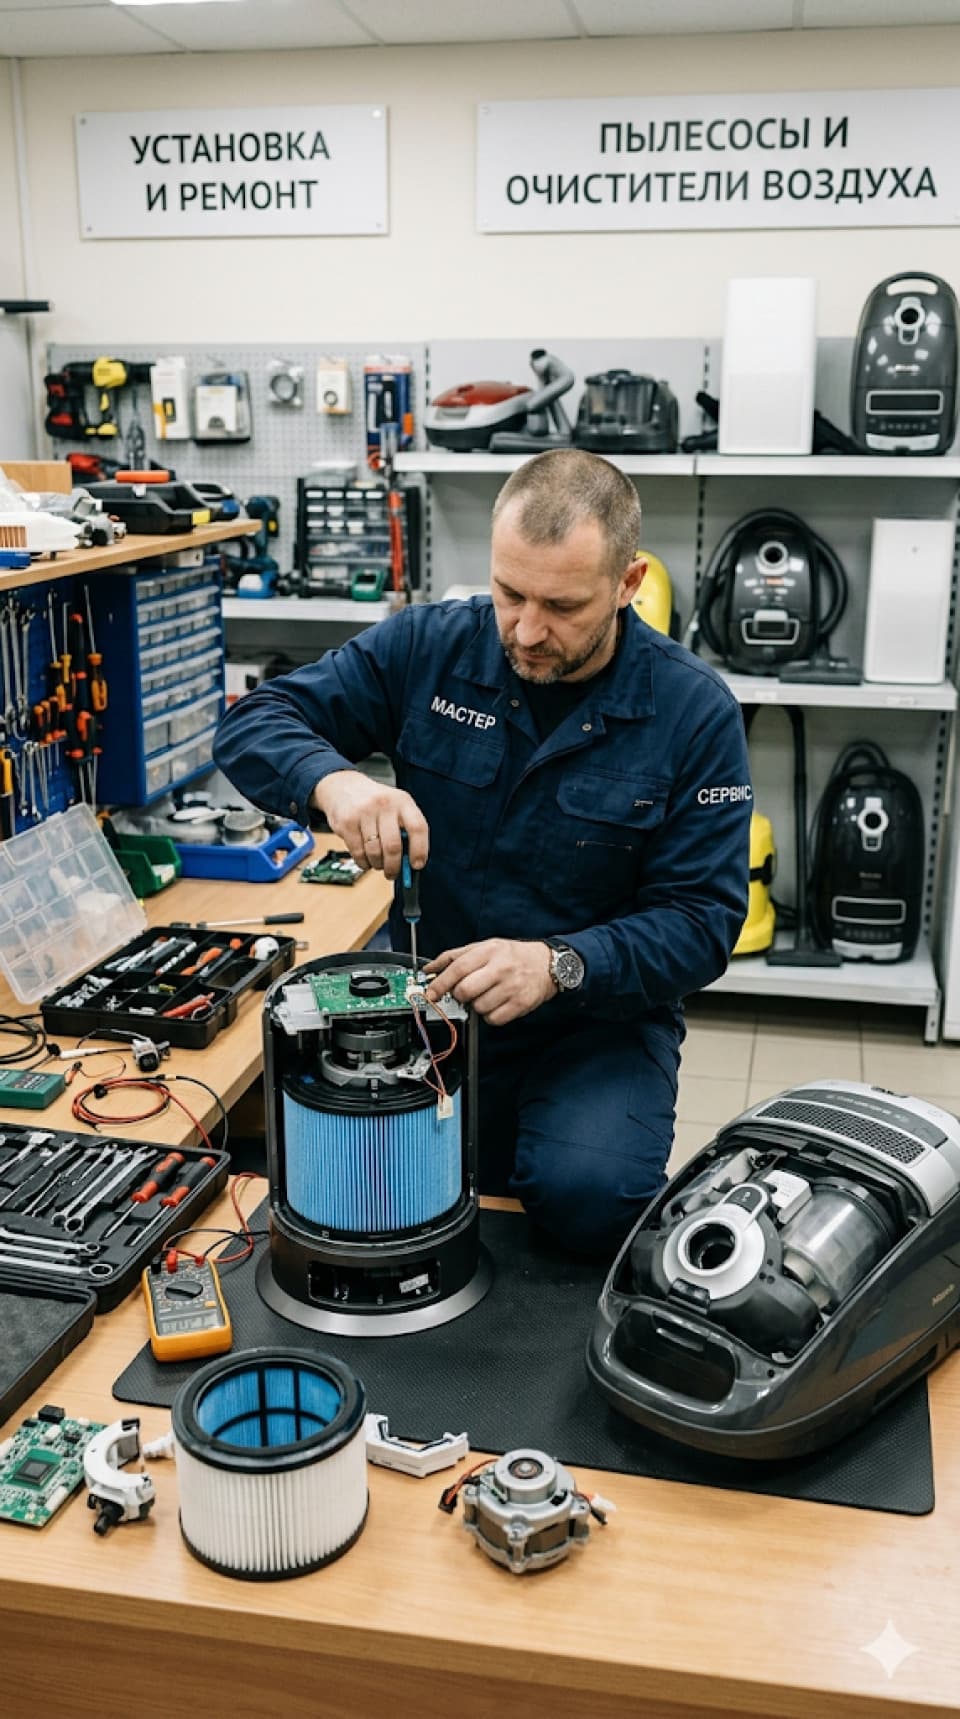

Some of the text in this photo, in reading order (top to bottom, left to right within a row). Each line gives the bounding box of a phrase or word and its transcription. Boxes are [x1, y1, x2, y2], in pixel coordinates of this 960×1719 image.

[130, 131, 331, 165] УСТАНОВКА
[600, 116, 849, 154] ПЫЛЕСОСЫ И
[145, 180, 319, 212] И РЕМОНТ
[505, 167, 938, 205] ОЧИСТИТЕЛИ ВОЗДУХА
[431, 695, 497, 731] МАСТЕР
[697, 784, 753, 805] СЕРВИС
